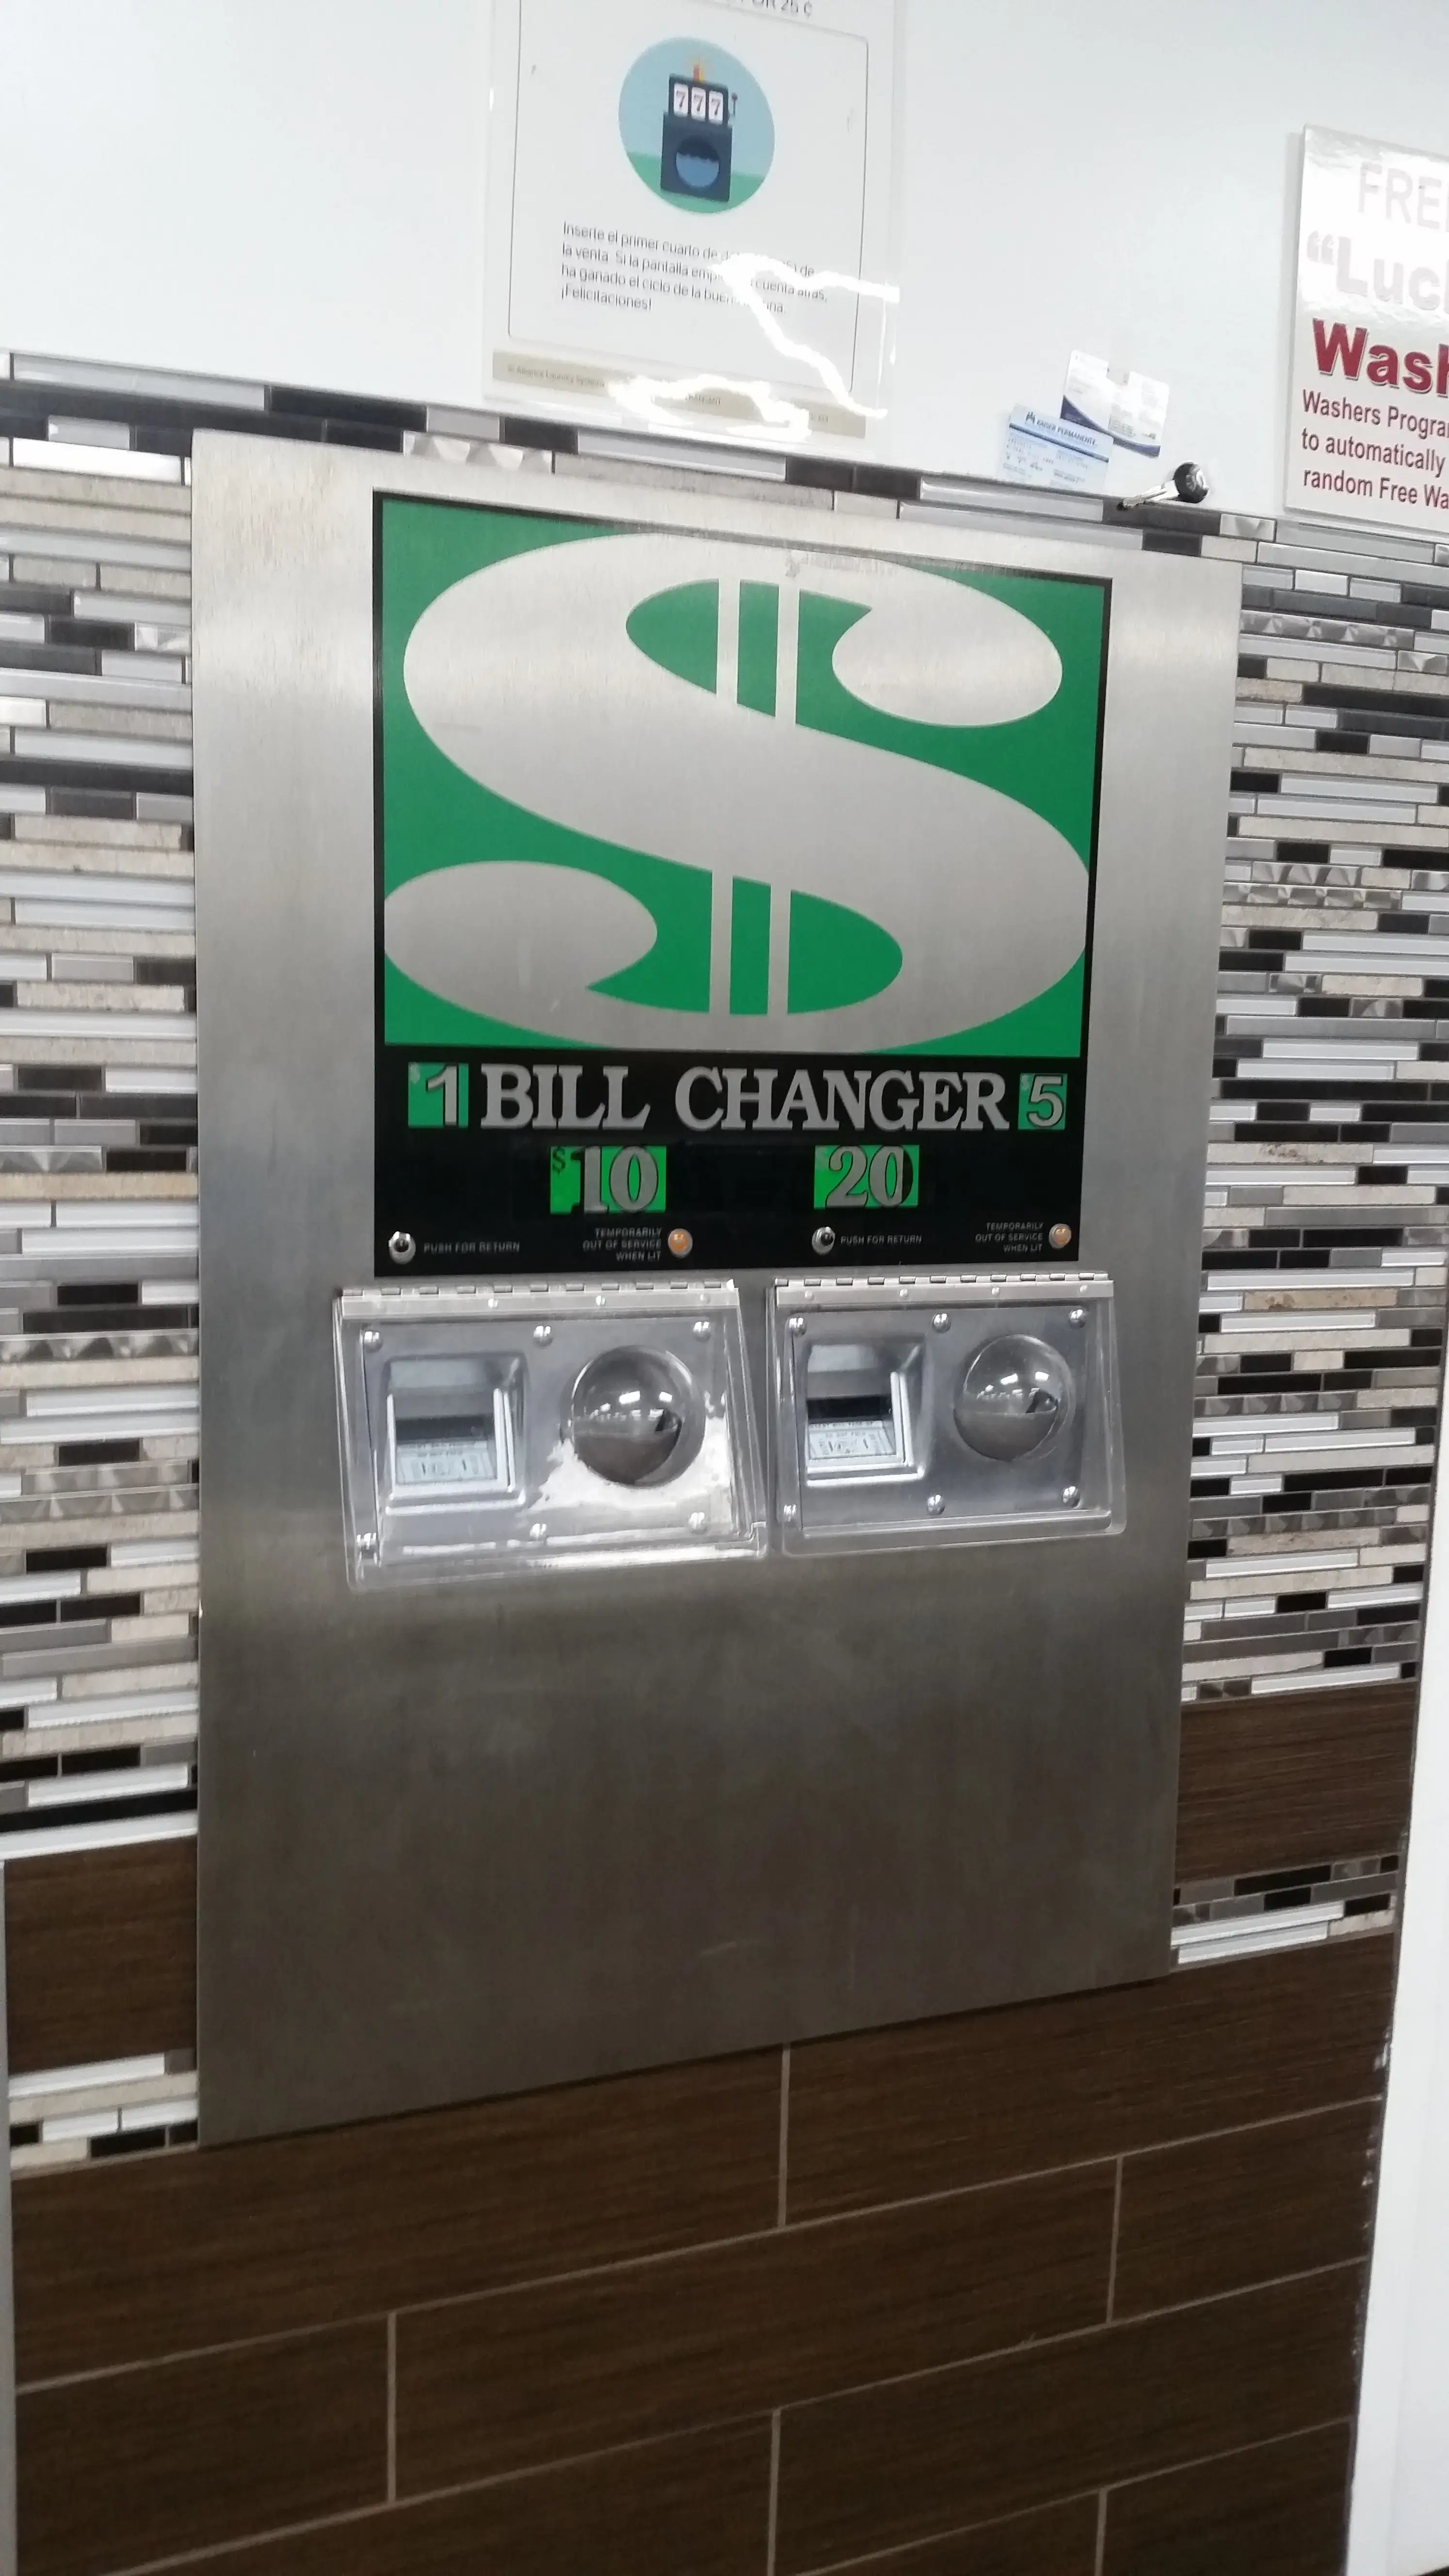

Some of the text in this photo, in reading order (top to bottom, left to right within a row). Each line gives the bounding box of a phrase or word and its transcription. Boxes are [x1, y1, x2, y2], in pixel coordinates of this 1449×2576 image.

[1358, 160, 1449, 234] FRE
[563, 221, 604, 241] Inserte
[608, 230, 618, 244] el
[621, 234, 659, 251] primer
[662, 241, 700, 257] cuarto
[703, 248, 718, 260] de
[563, 242, 572, 257] la
[615, 249, 626, 266] Si
[629, 253, 639, 268] la
[642, 258, 689, 277] pantalla
[562, 262, 576, 278] ha
[580, 268, 626, 285] ganado
[629, 275, 640, 288] el
[643, 278, 671, 292] ciclo
[674, 282, 689, 297] de
[692, 285, 701, 298] la
[562, 282, 651, 310] ¡Felicitaciones!
[1303, 389, 1449, 439] Washers Progra
[1302, 428, 1446, 478] to automatically
[1304, 469, 1372, 497] random
[1380, 477, 1417, 504] Free
[481, 1063, 651, 1129] BILL
[675, 1066, 1010, 1131] CHANGER
[595, 1227, 662, 1239] TEMPORARILY
[840, 1234, 921, 1246] PUSH FOR RETURN
[975, 1233, 1043, 1243] OUT OF SERVICE
[986, 1222, 1043, 1231] TEMPORARILY
[424, 1241, 519, 1254] PUSH FOR RETURN
[582, 1239, 661, 1251] OUT OF SERVICE
[615, 1250, 661, 1261] WHEN LIT
[1003, 1243, 1042, 1252] WHEN LIT
